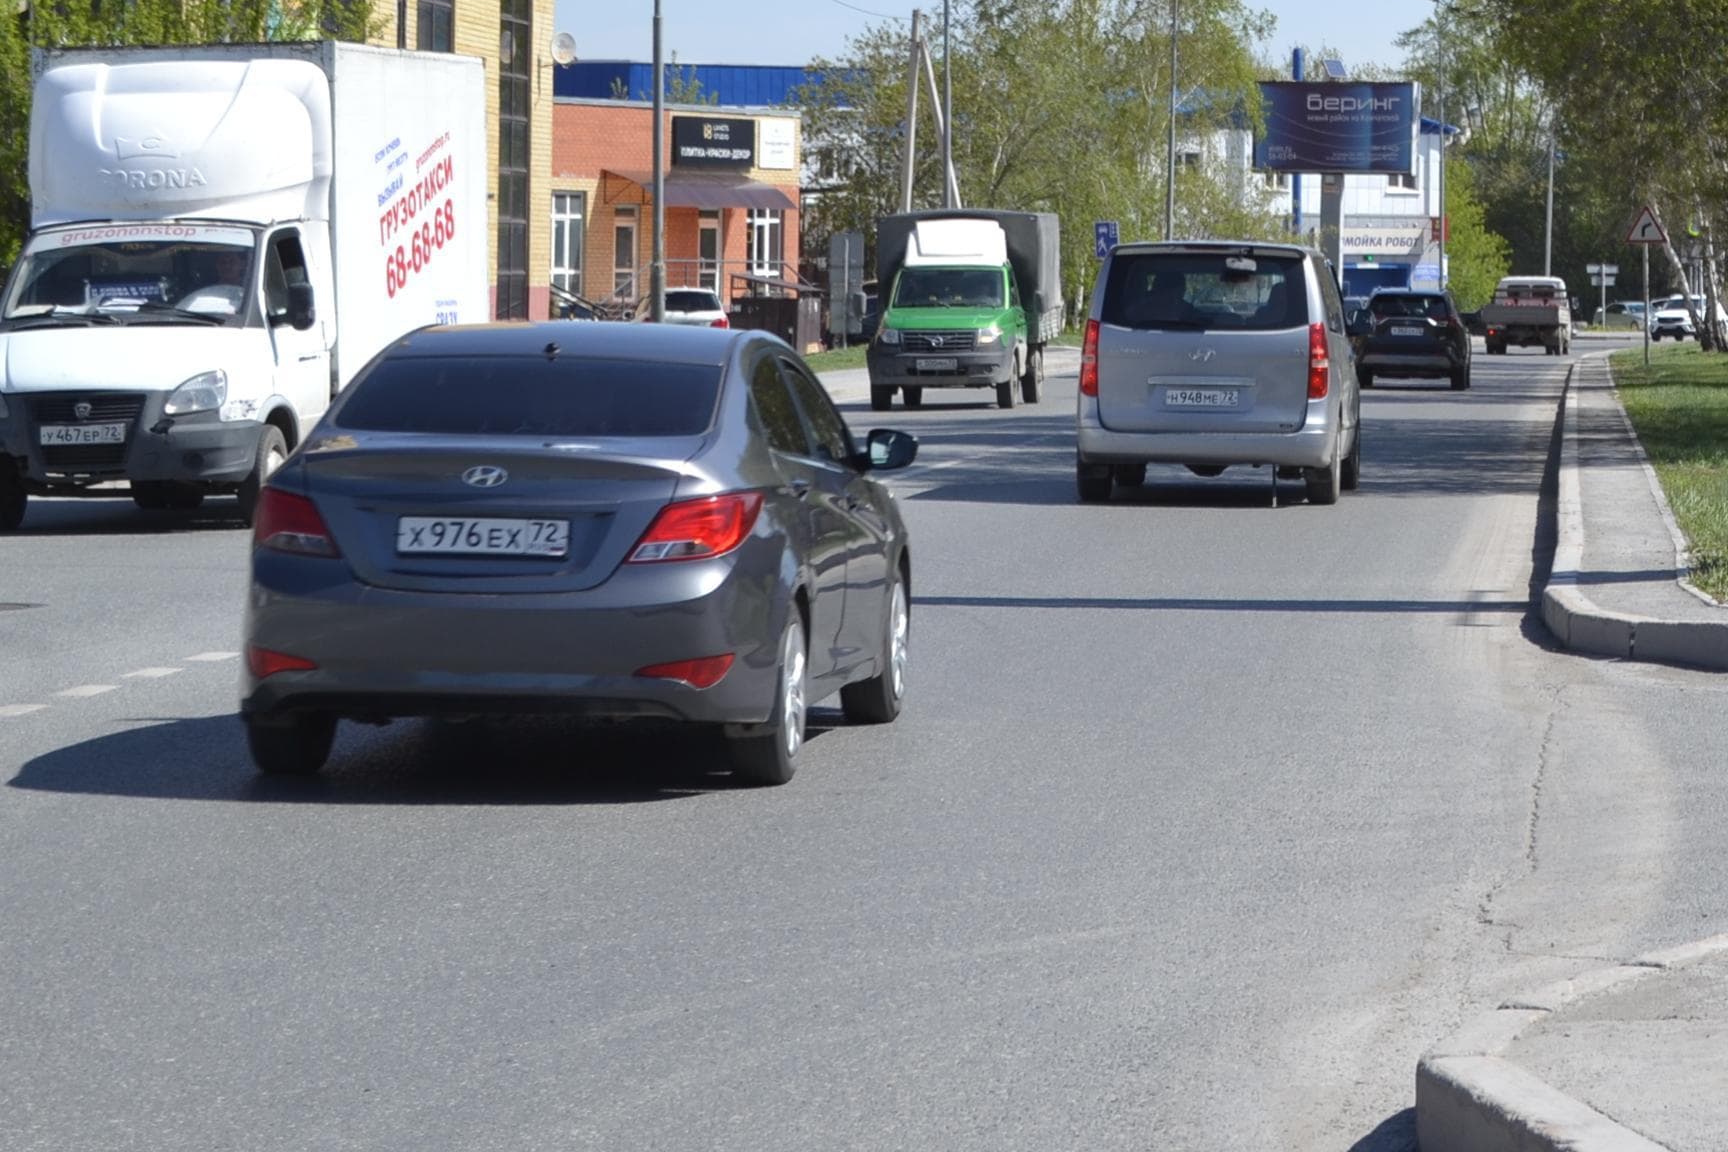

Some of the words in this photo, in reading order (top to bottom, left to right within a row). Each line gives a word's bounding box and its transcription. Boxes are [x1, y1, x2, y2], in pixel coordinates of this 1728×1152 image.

[1307, 94, 1400, 112] беринг
[379, 154, 454, 246] ГРУЗОТАКСИ
[386, 198, 455, 298] 68-68-68
[1341, 235, 1382, 247] МОЙКА
[1385, 236, 1420, 248] РОБОТ
